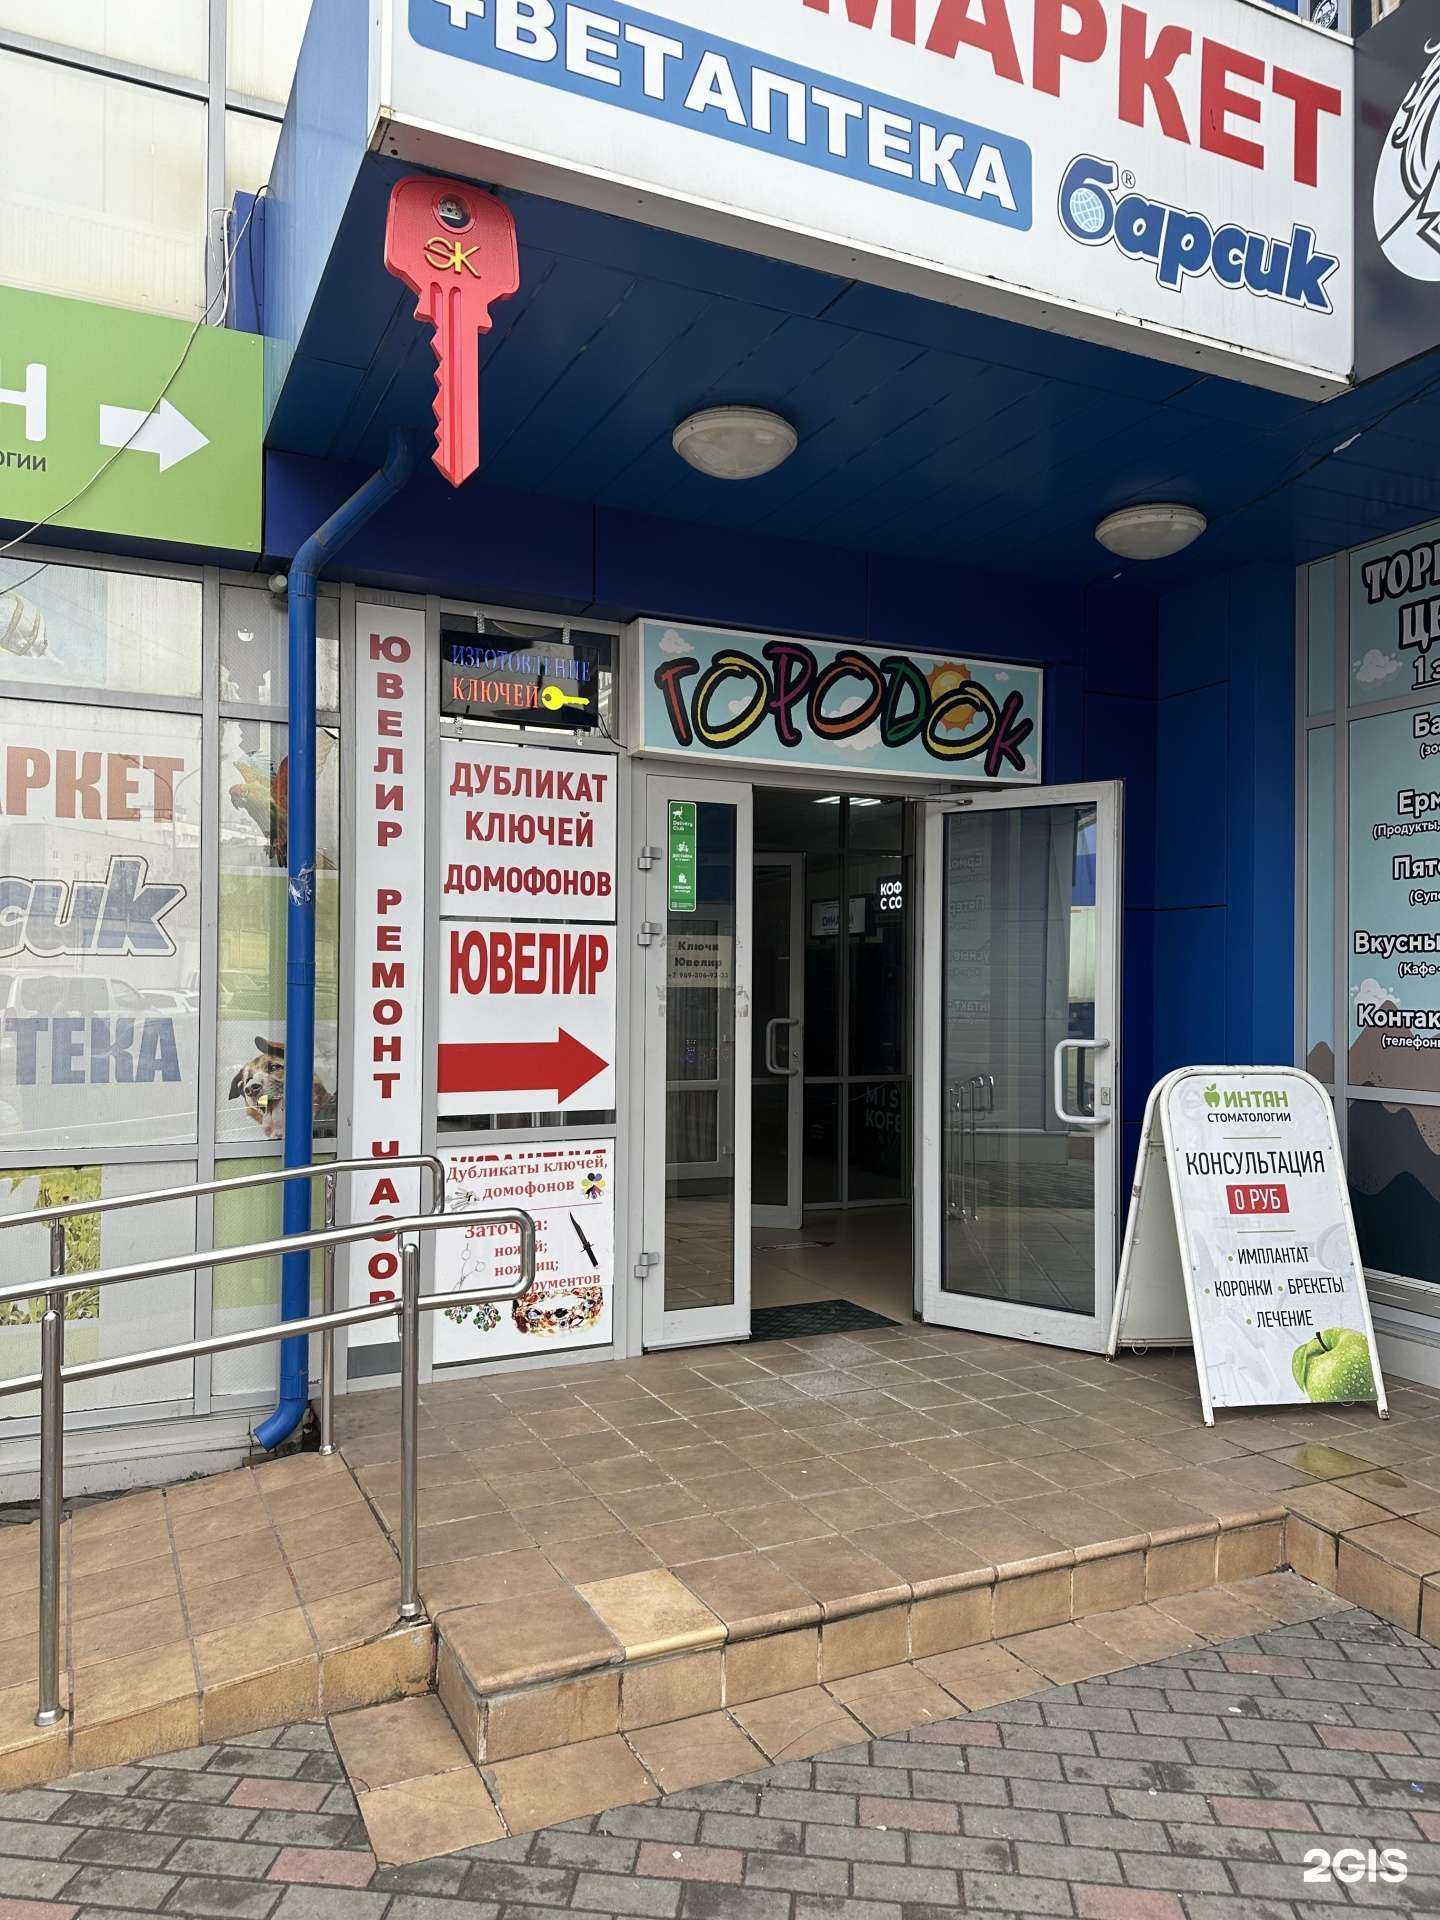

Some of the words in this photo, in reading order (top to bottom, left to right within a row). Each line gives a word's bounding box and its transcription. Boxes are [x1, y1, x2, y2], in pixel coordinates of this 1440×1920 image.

[452, 676, 540, 709] КЛЮЧЕЙ
[369, 633, 411, 847] ЮВЕЛИР
[0, 746, 184, 824] РКЕТ
[450, 762, 607, 803] ДУБЛИКАТ
[465, 810, 594, 847] КЛЮЧЕЙ
[443, 863, 612, 896] ДОМОФОНОВ
[678, 941, 719, 951] Ключи
[449, 930, 609, 995] ЮВЕЛИР
[674, 957, 722, 969] Ювелир
[372, 888, 405, 1099] РЕМОНТ
[4, 1017, 182, 1085] ТЕКА
[1223, 1090, 1288, 1108] ИНТАН
[1207, 1112, 1292, 1123] СТОМАТОЛОГИИ
[447, 1164, 539, 1182] Дубликаты
[543, 1156, 608, 1173] ключей,
[1185, 1150, 1325, 1177] КОНСУЛЬТАЦИЯ
[482, 1180, 575, 1200] домофонов
[1250, 1188, 1281, 1210] РУБ
[464, 1219, 548, 1239] Заточа:
[1237, 1247, 1310, 1265] ИМПЛАНТАТ
[530, 1274, 601, 1294] рументов
[1214, 1280, 1273, 1298] КОРОНКИ
[1287, 1277, 1345, 1294] БРЕКЕТЫ
[1256, 1309, 1314, 1328] ЛЕЧЕНИЕ
